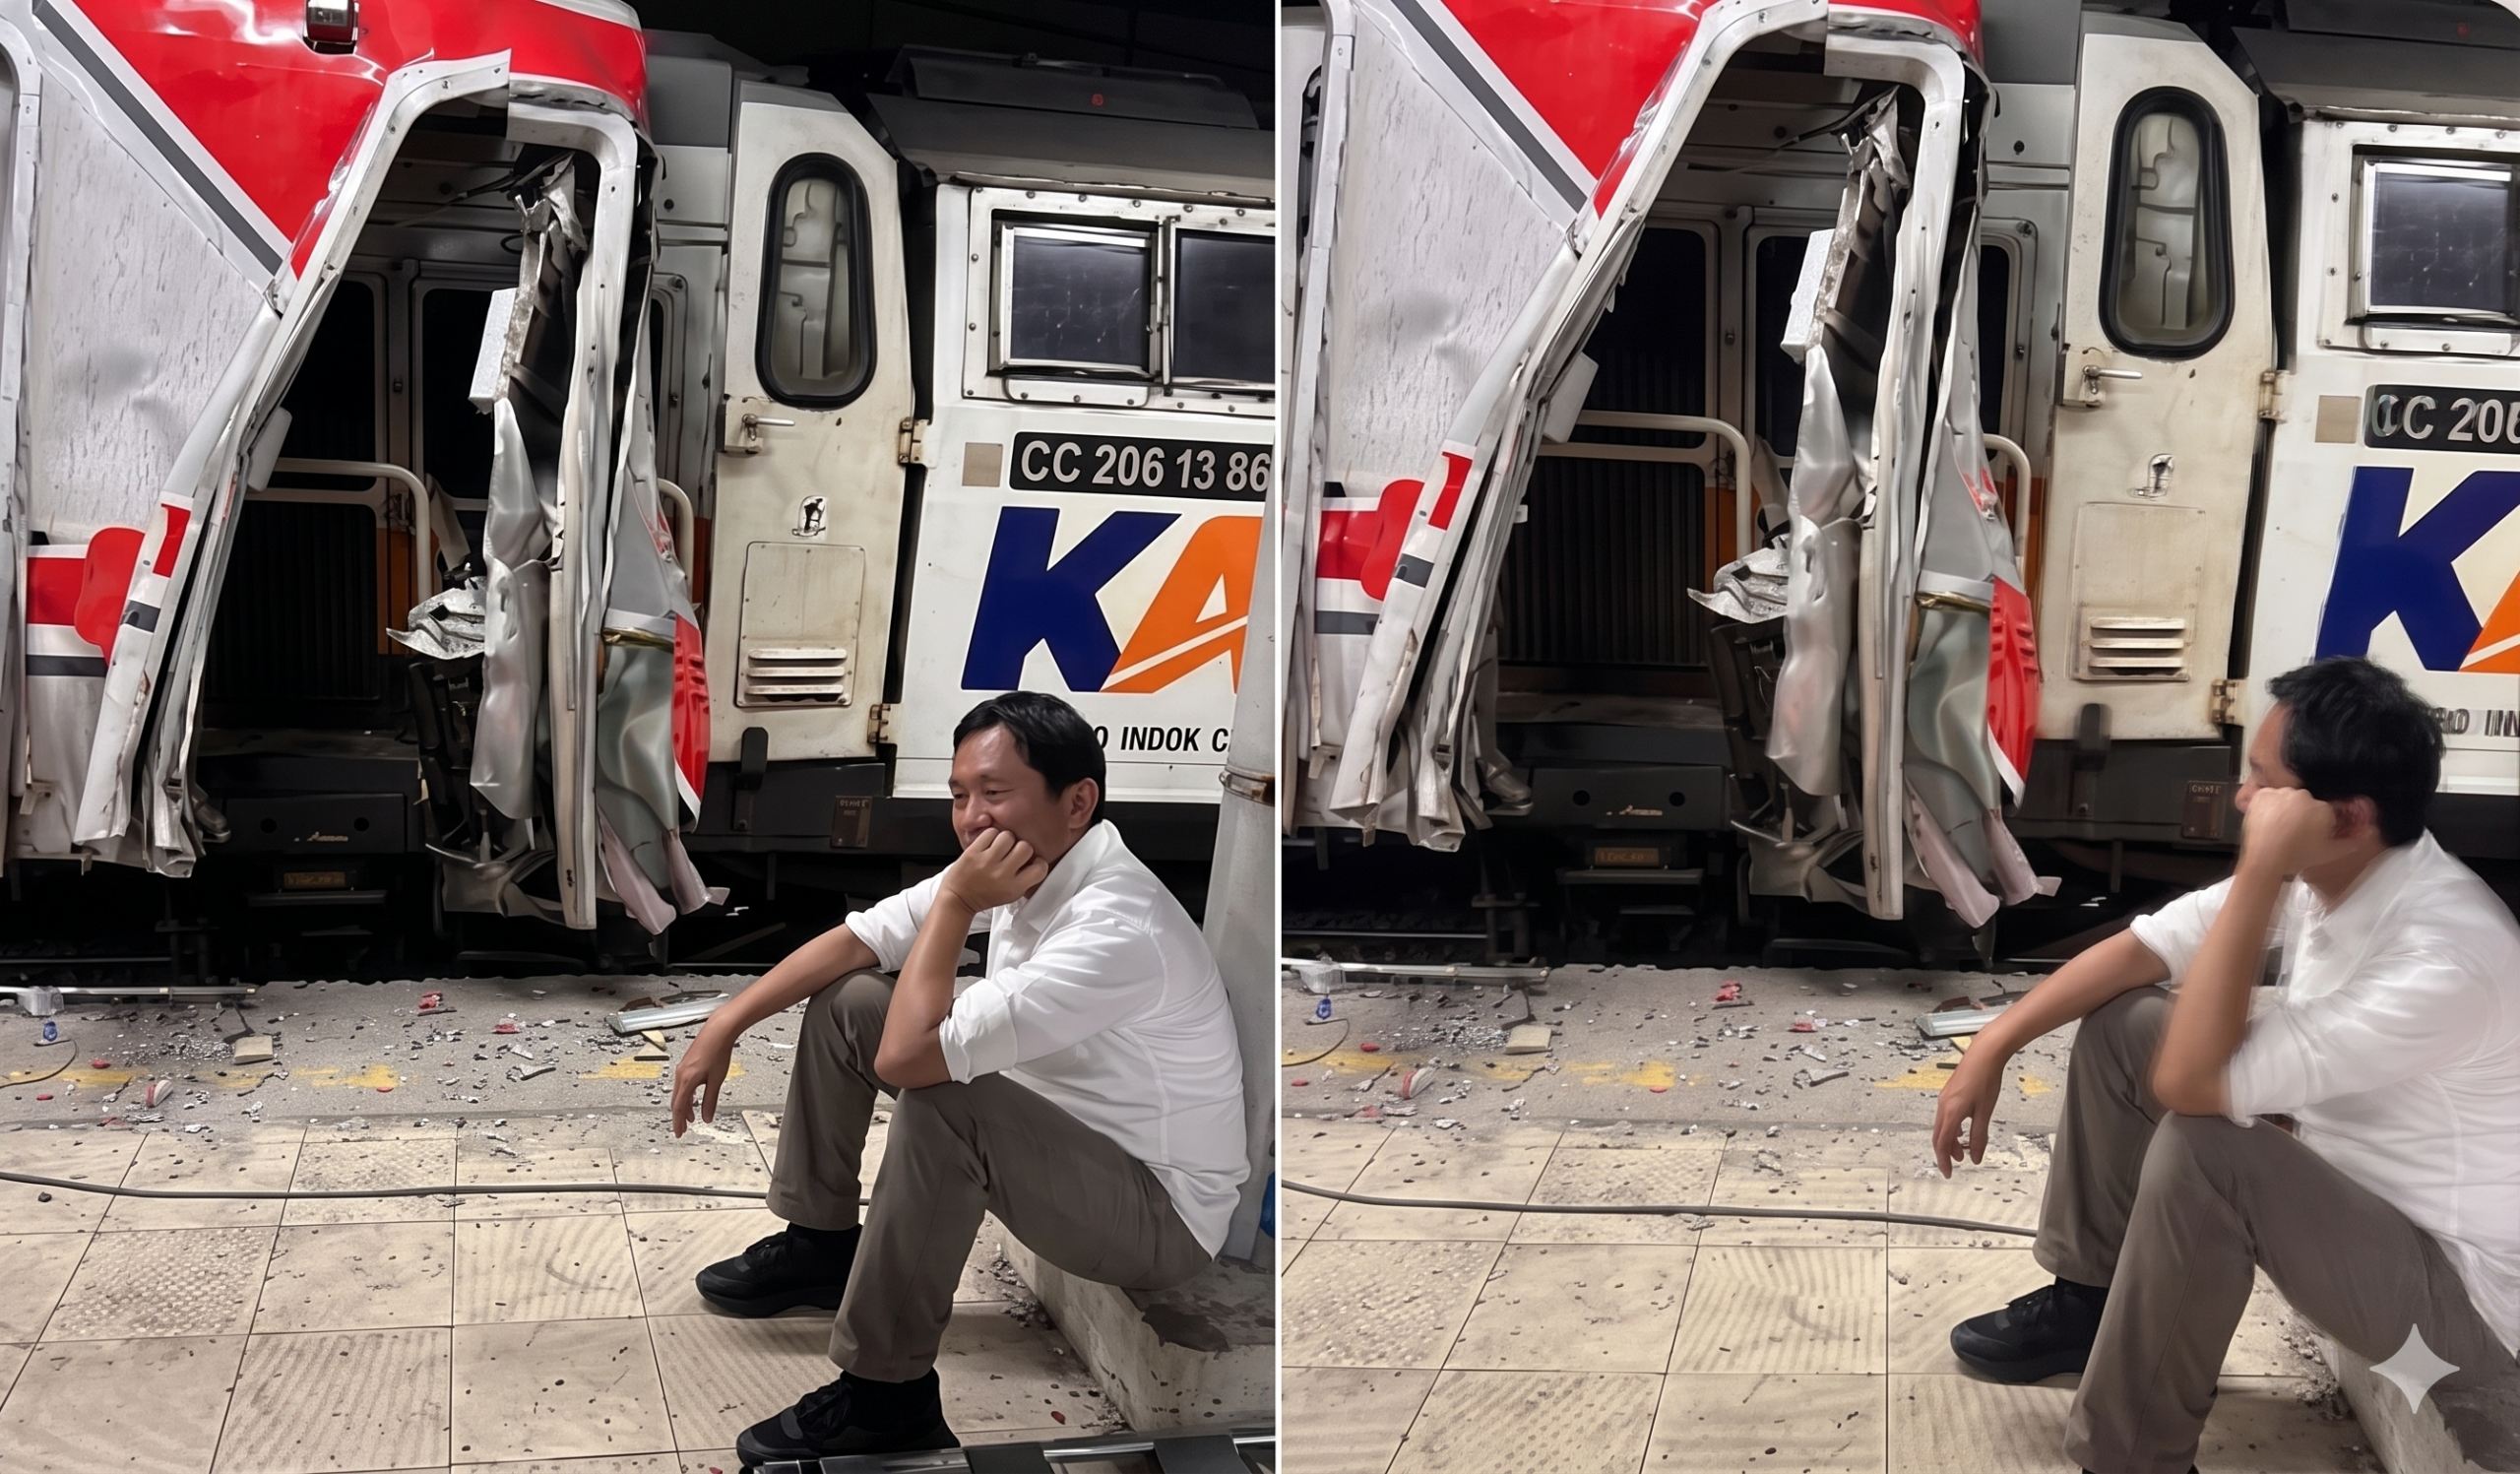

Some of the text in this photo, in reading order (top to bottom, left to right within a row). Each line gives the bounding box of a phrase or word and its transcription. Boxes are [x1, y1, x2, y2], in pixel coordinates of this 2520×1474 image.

[1021, 440, 1271, 492] CC 206 13 86
[1120, 726, 1201, 751] INDOK
[1212, 728, 1231, 752] C
